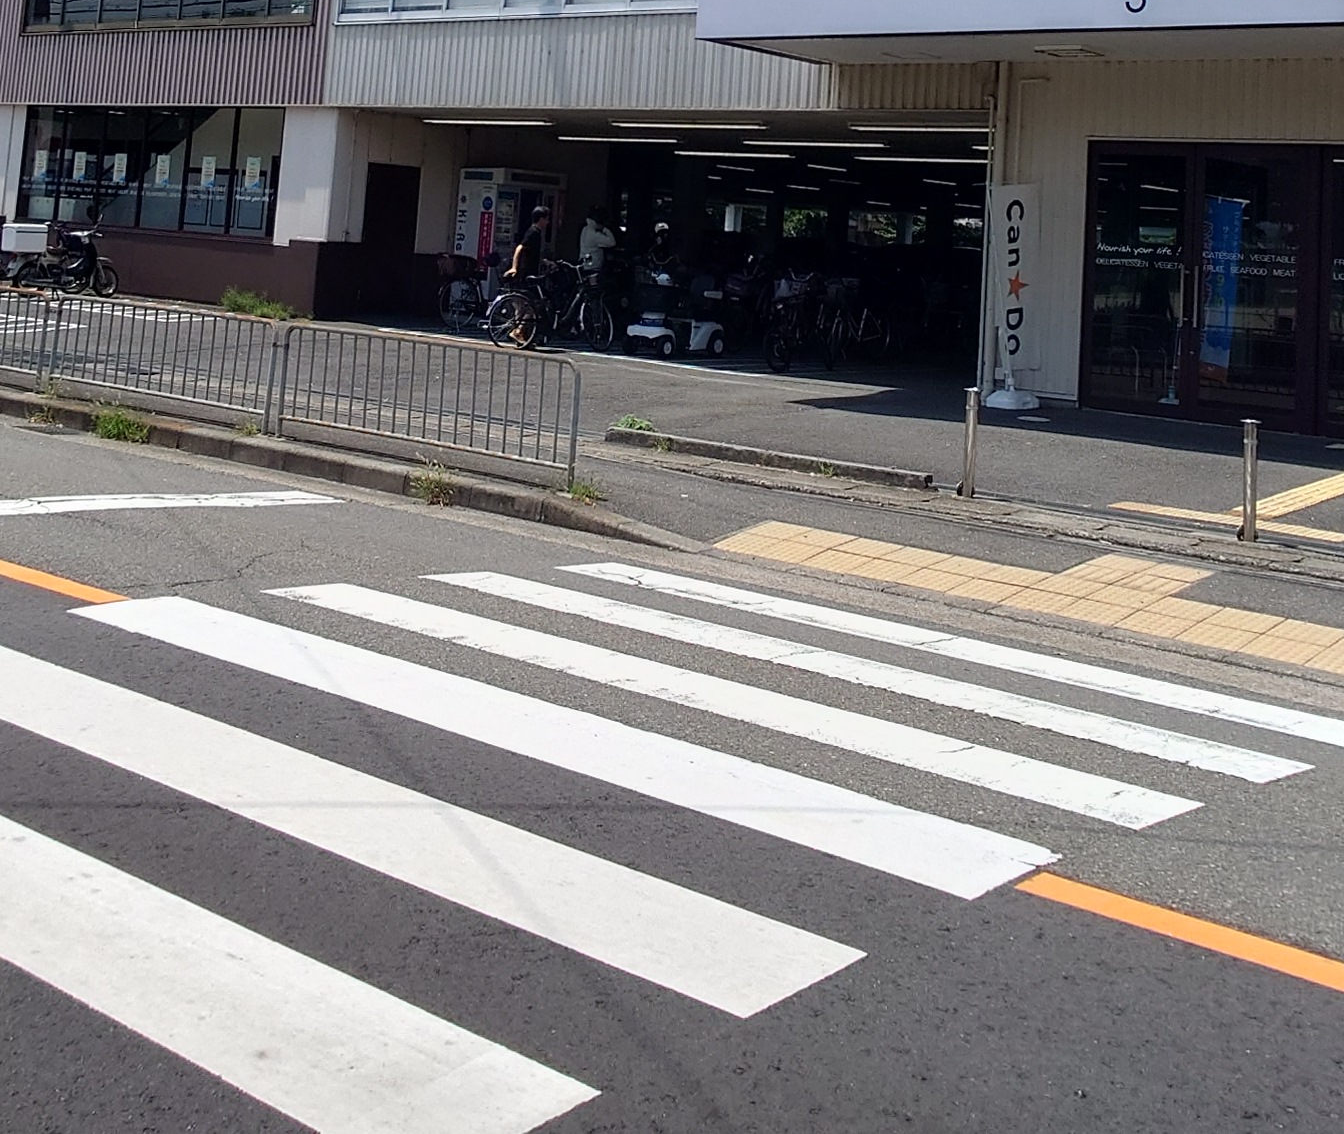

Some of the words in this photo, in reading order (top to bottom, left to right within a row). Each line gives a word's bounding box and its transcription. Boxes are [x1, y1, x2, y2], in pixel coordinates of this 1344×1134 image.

[1006, 199, 1025, 267] Can
[1096, 242, 1132, 253] Nourish
[1133, 246, 1155, 256] your
[1156, 246, 1173, 255] life
[1249, 253, 1297, 264] VEGETABLE
[1230, 266, 1268, 276] SEAFOOD
[1272, 268, 1297, 278] MEAT
